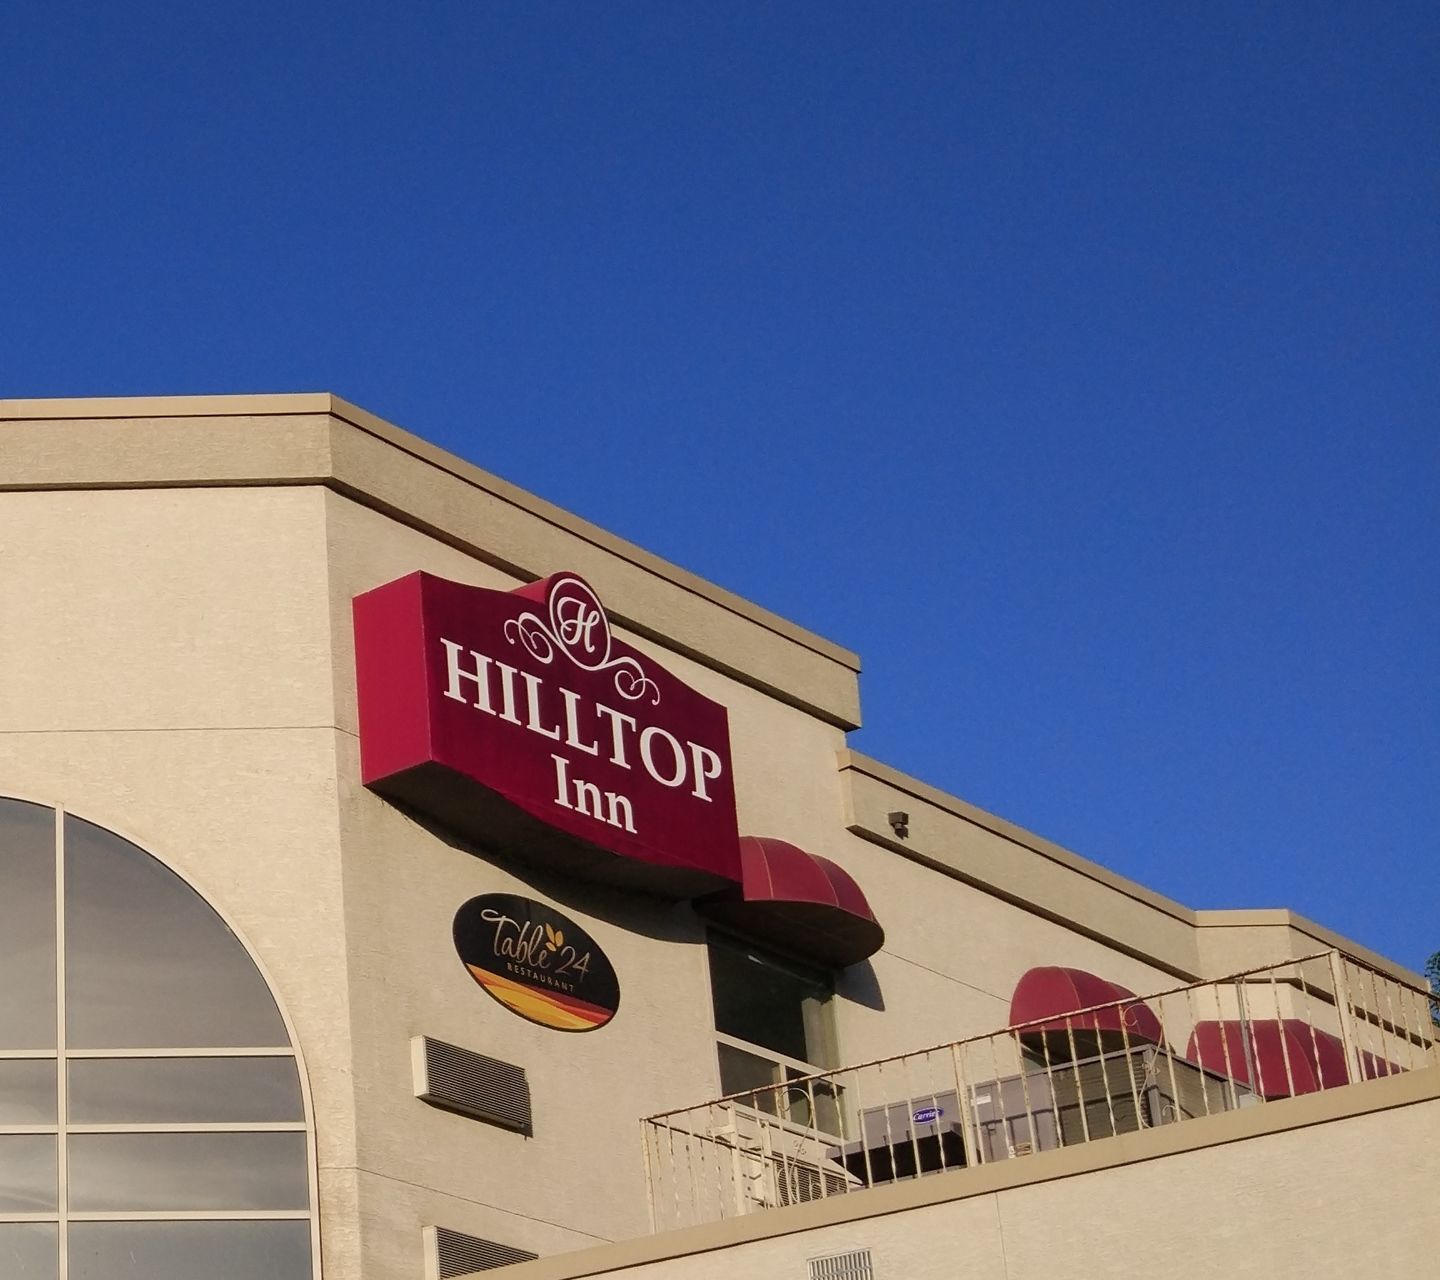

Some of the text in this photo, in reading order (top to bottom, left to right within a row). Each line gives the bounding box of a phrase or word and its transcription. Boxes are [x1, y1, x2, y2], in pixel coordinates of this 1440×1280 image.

[440, 637, 722, 803] HILLTOP
[551, 753, 638, 834] Inn
[480, 908, 590, 983] Table 24
[507, 962, 575, 993] RESTAURANT
